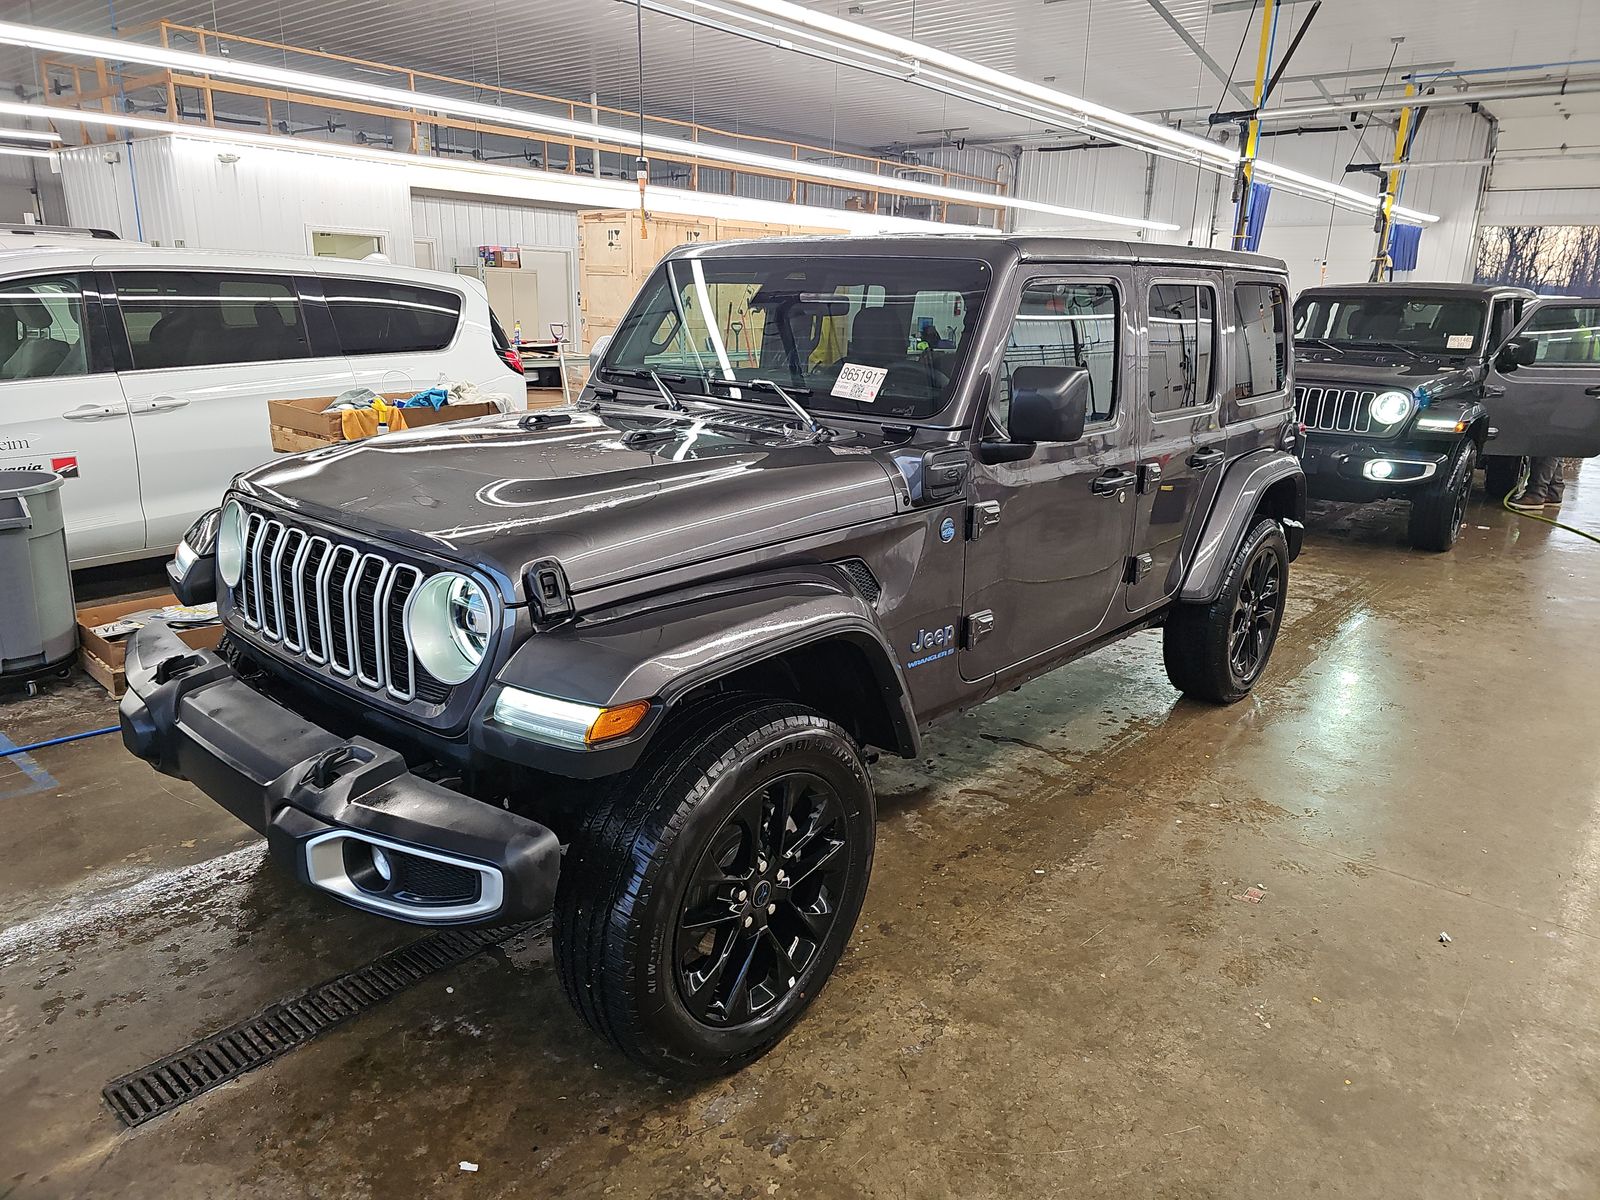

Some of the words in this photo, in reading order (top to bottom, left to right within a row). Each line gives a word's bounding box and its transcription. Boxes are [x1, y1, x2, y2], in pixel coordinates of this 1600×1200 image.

[840, 366, 886, 386] 8651917
[0, 436, 30, 451] eim
[911, 624, 955, 653] Jeep
[907, 650, 948, 669] WRANGLER
